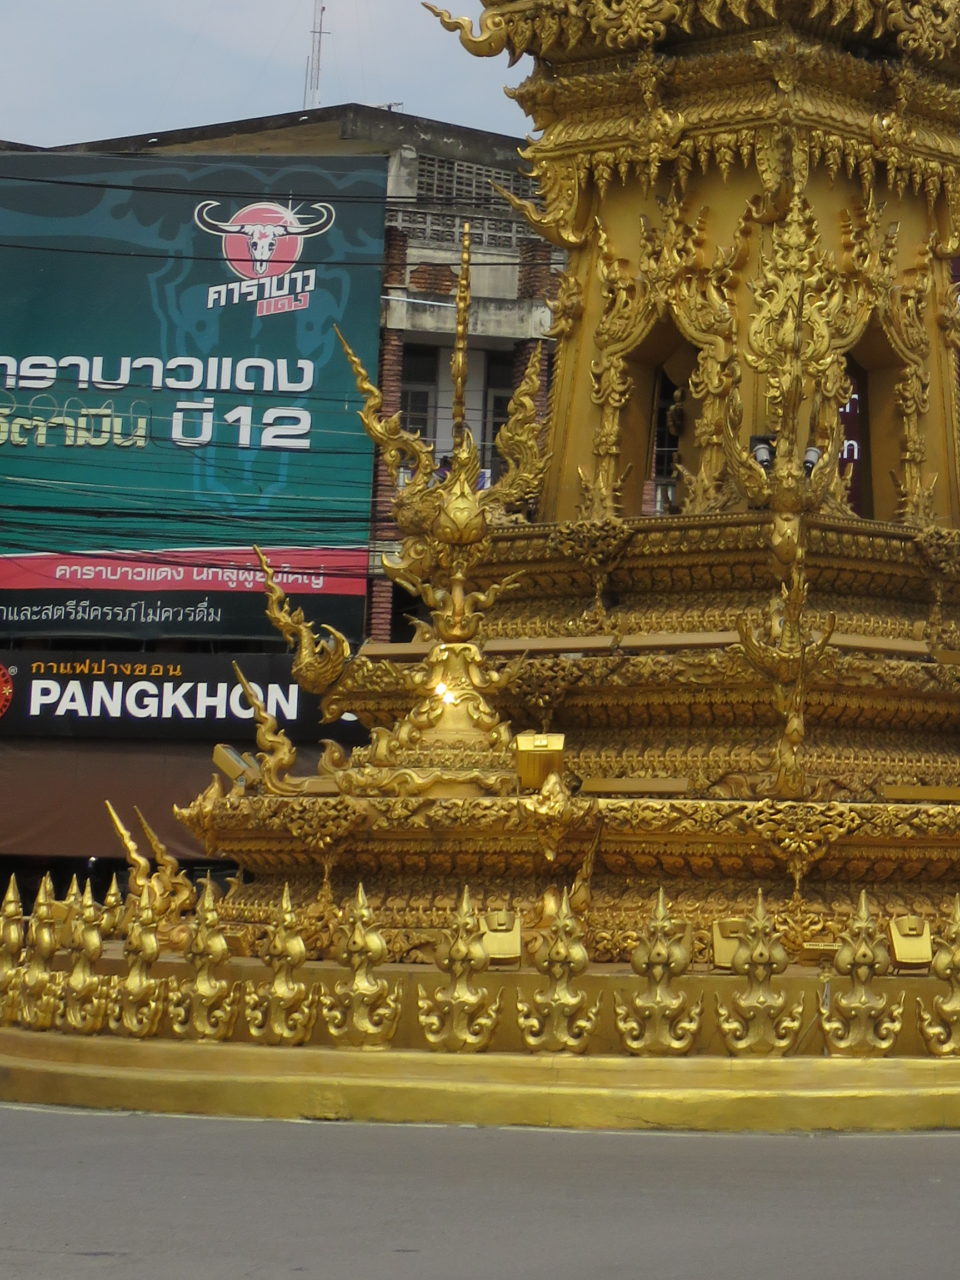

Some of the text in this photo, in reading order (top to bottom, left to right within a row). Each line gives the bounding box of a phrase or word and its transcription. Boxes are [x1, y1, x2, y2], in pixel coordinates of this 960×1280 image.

[207, 268, 316, 309] คาราบาว
[256, 292, 311, 318] แดง
[172, 397, 215, 448] ปี
[223, 405, 312, 450] 12
[55, 563, 185, 582] คาราบาวแดง
[31, 658, 183, 677] กาแฟปางขอน
[30, 678, 299, 721] PANGKHON
